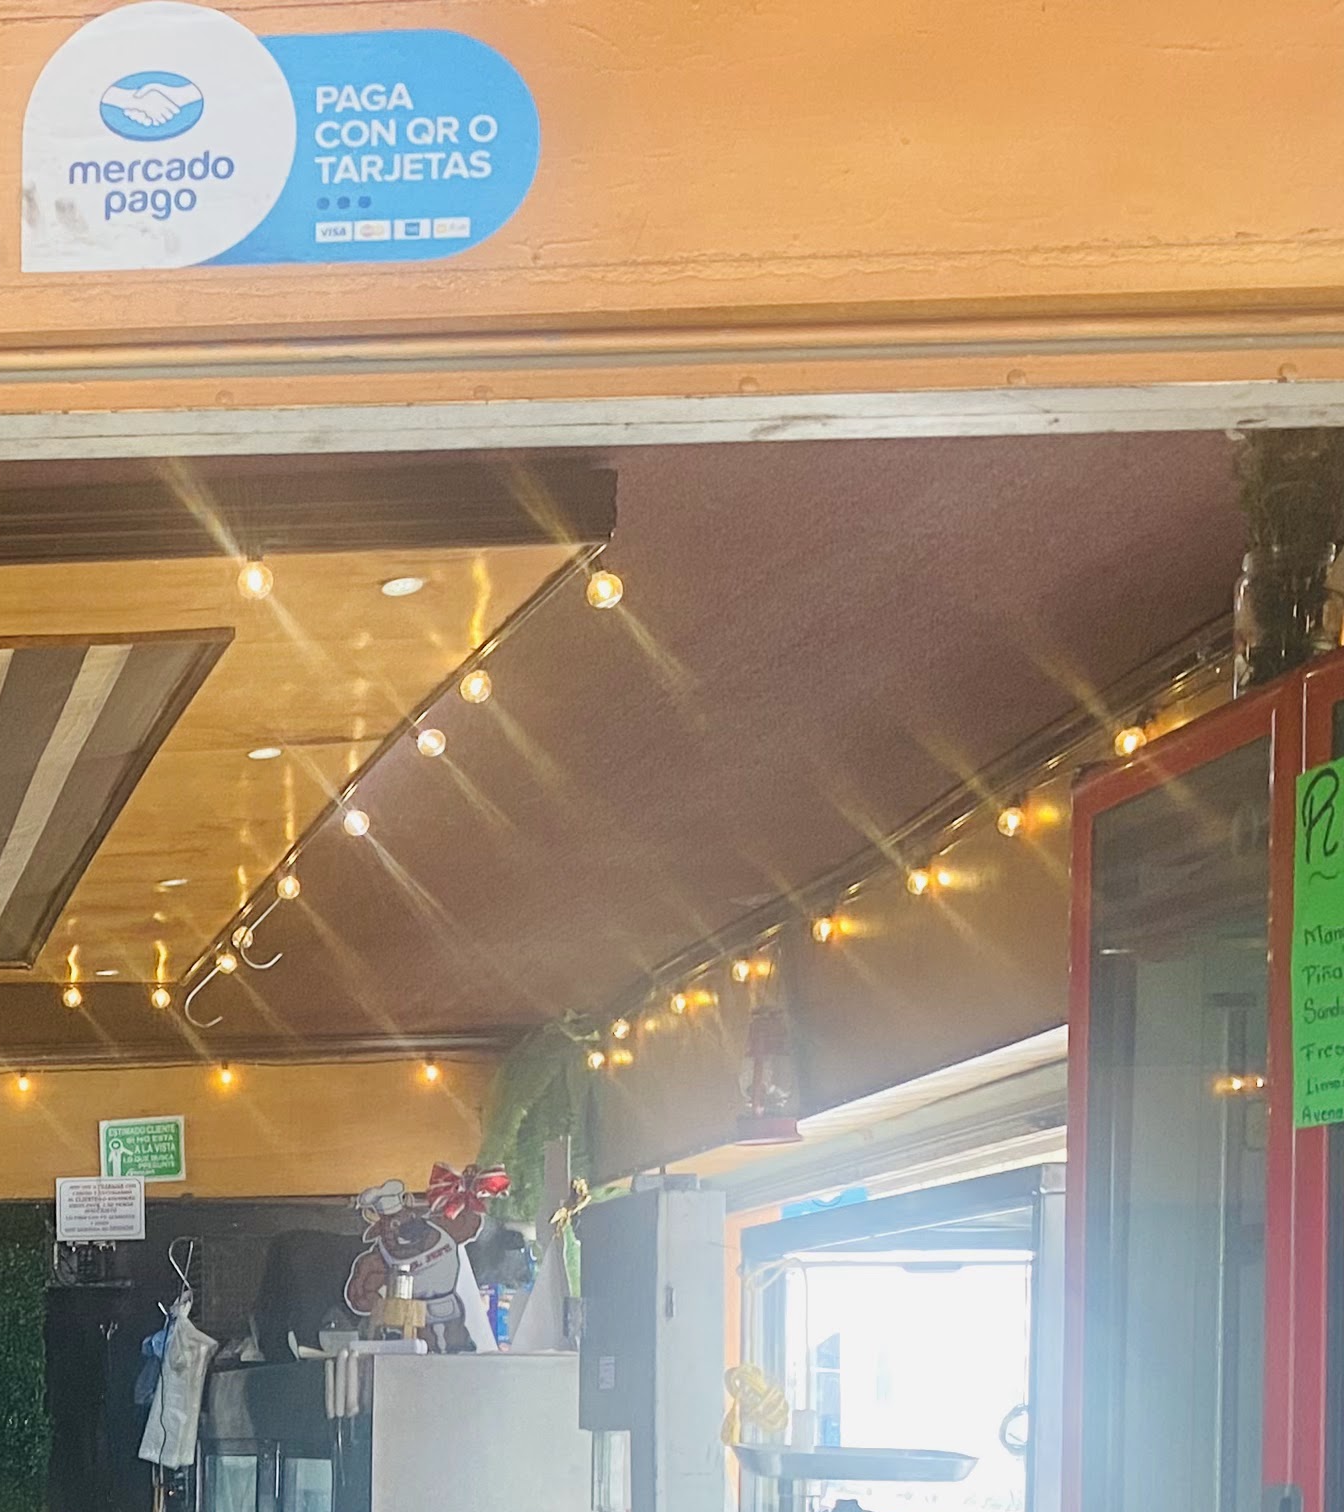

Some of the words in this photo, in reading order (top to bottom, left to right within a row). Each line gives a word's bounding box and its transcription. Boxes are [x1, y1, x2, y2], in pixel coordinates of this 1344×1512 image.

[315, 82, 414, 114] PAGA
[314, 117, 397, 149] CON
[405, 115, 460, 145] QR
[468, 114, 498, 143] O
[69, 150, 235, 184] mercado
[314, 149, 493, 185] TARJETAS
[104, 188, 197, 220] pago
[321, 227, 347, 237] VISA
[1301, 964, 1343, 989] Piña
[146, 1124, 176, 1135] CLIENTE
[134, 1145, 141, 1154] A
[141, 1143, 153, 1154] LA
[153, 1142, 176, 1152] VISTA
